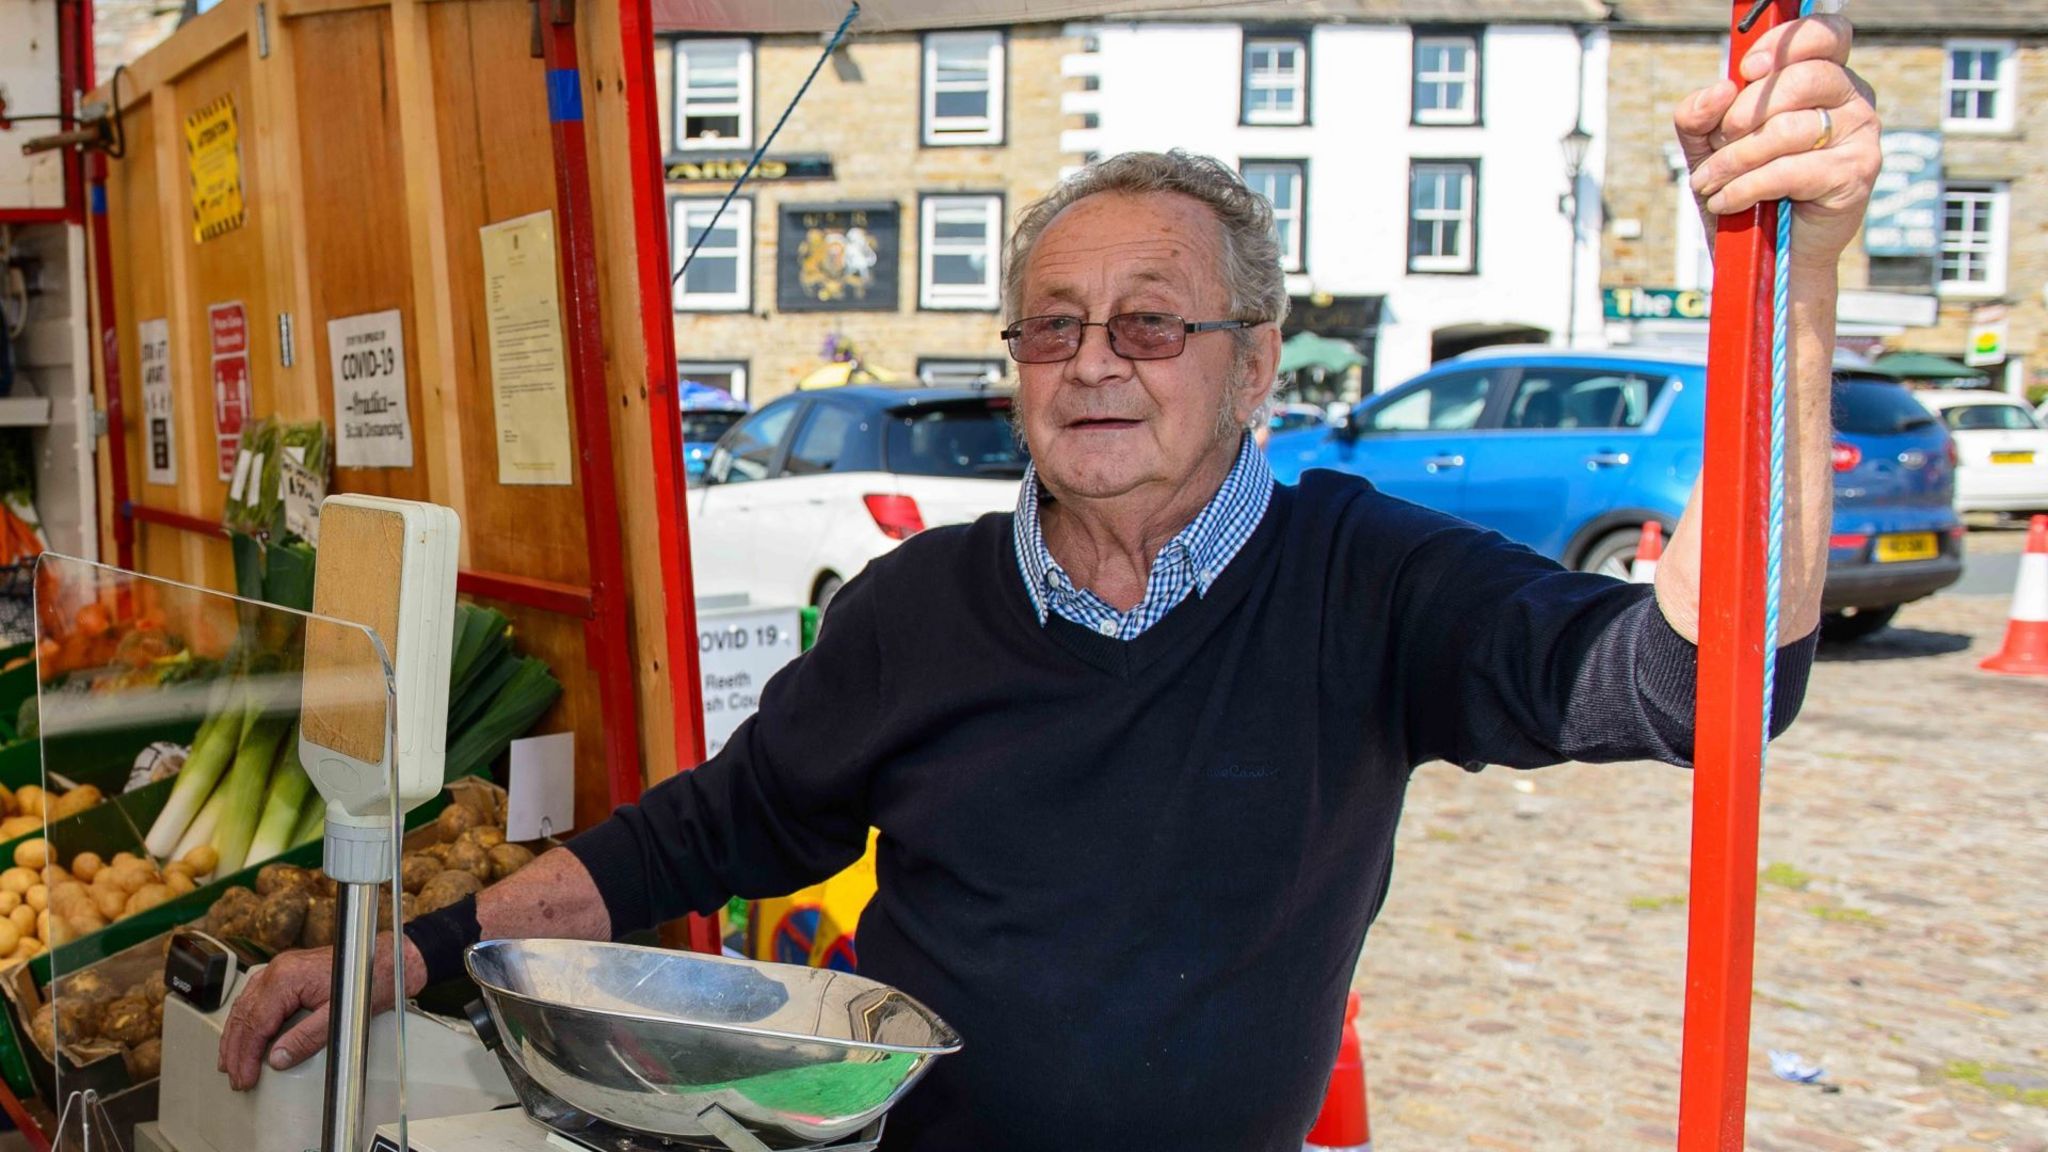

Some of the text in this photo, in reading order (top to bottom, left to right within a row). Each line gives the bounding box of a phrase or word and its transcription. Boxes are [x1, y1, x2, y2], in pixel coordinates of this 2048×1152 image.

[1611, 287, 1672, 318] The
[341, 347, 394, 381] COVID-19
[699, 625, 778, 653] OVID 19
[705, 672, 751, 690] Reeth
[706, 692, 759, 712] sh Cou
